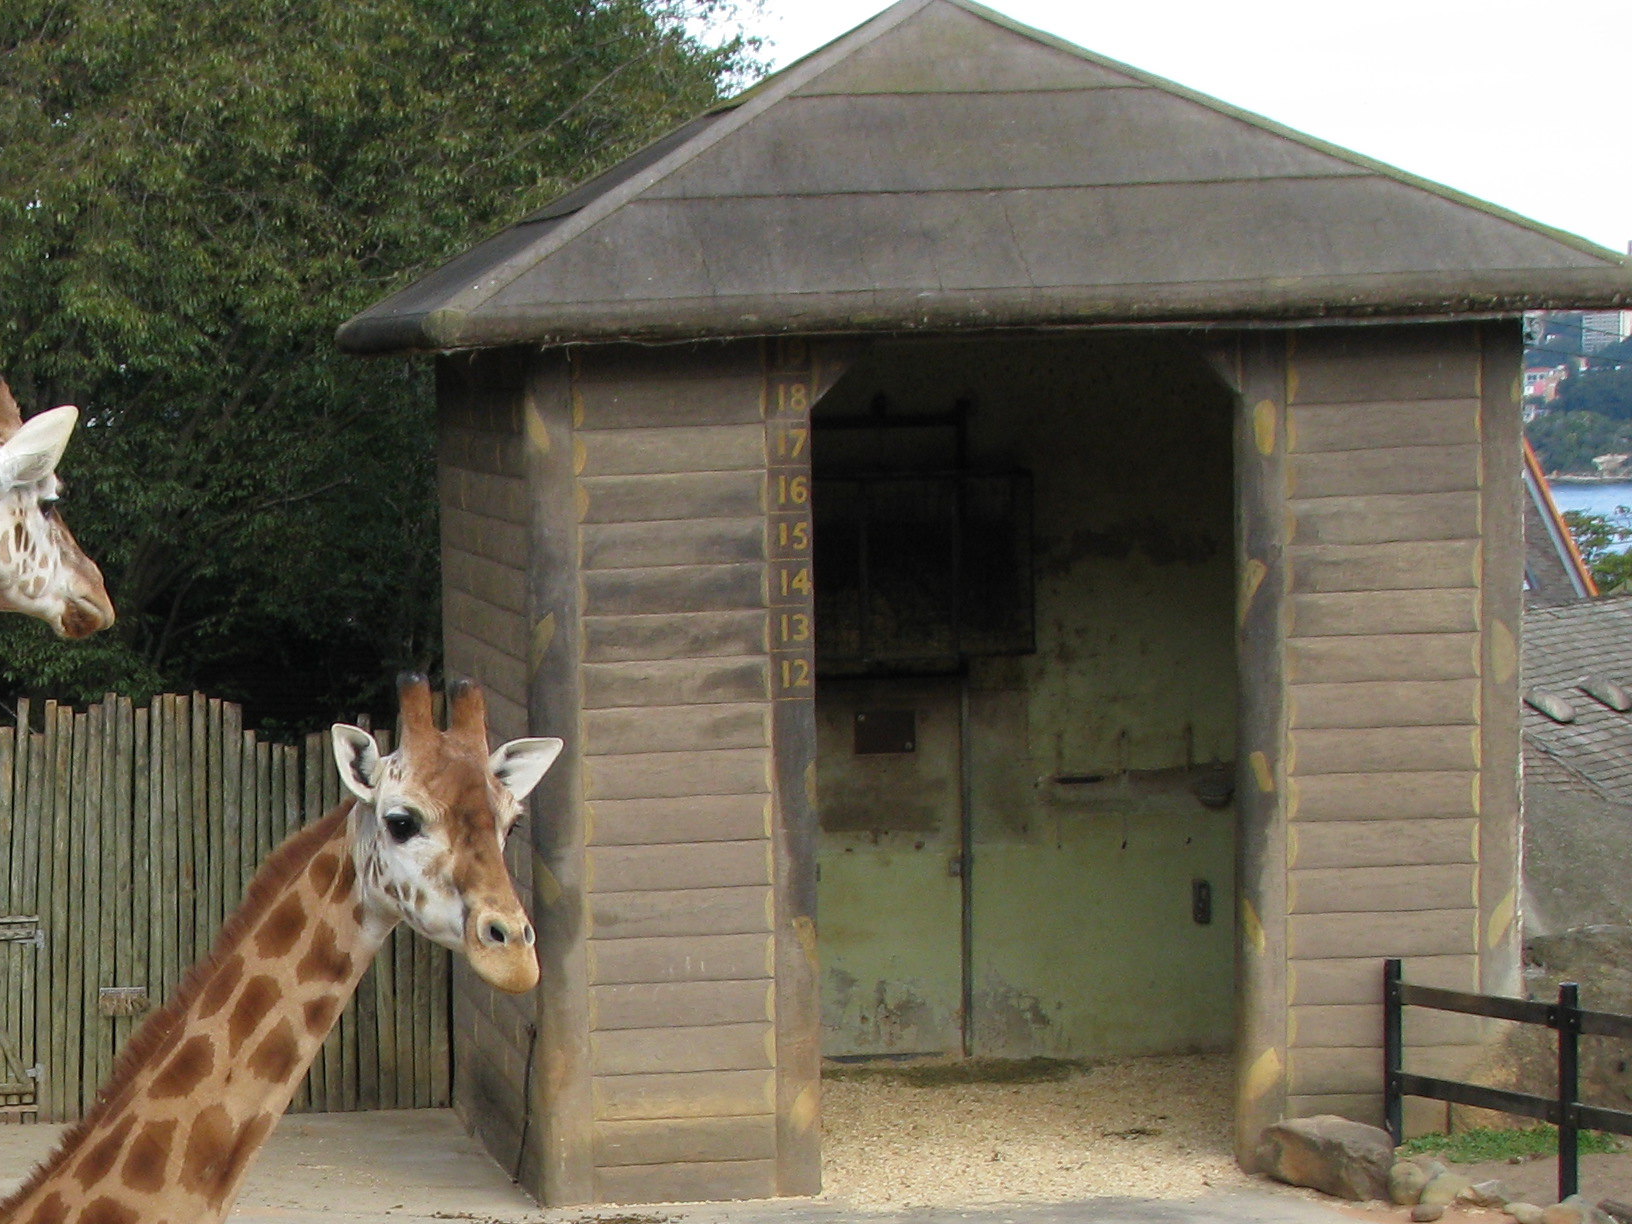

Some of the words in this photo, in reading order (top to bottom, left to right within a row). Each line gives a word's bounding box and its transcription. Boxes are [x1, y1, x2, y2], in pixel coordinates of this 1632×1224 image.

[778, 384, 806, 411] 18
[778, 429, 807, 458] 17
[779, 476, 807, 504] 16
[779, 522, 808, 550] 15
[781, 569, 811, 596] 14
[781, 614, 810, 642] 13
[782, 659, 810, 688] 12
